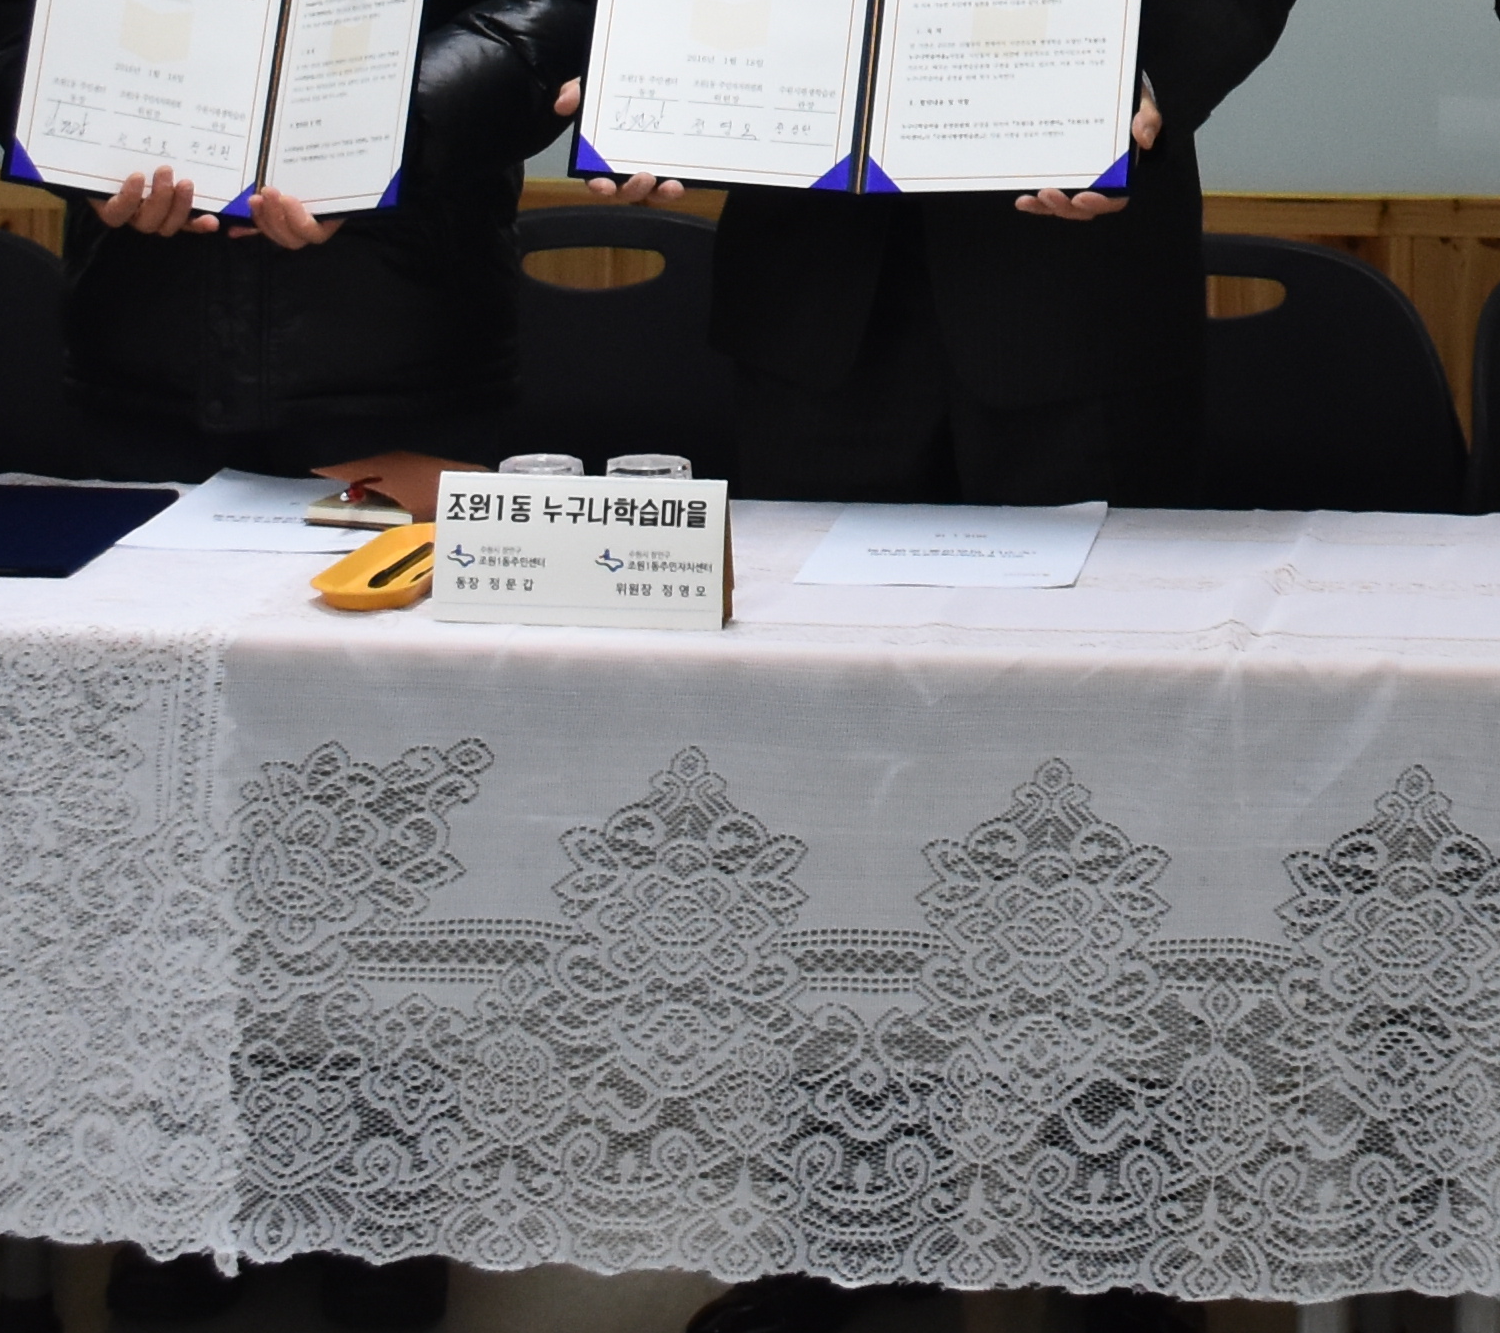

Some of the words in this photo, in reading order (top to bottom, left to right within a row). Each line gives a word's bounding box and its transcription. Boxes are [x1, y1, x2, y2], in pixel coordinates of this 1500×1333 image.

[446, 493, 531, 523] 조원1동
[543, 496, 707, 528] 누구나학습마을
[456, 576, 479, 590] 동장
[615, 582, 652, 597] 위원장
